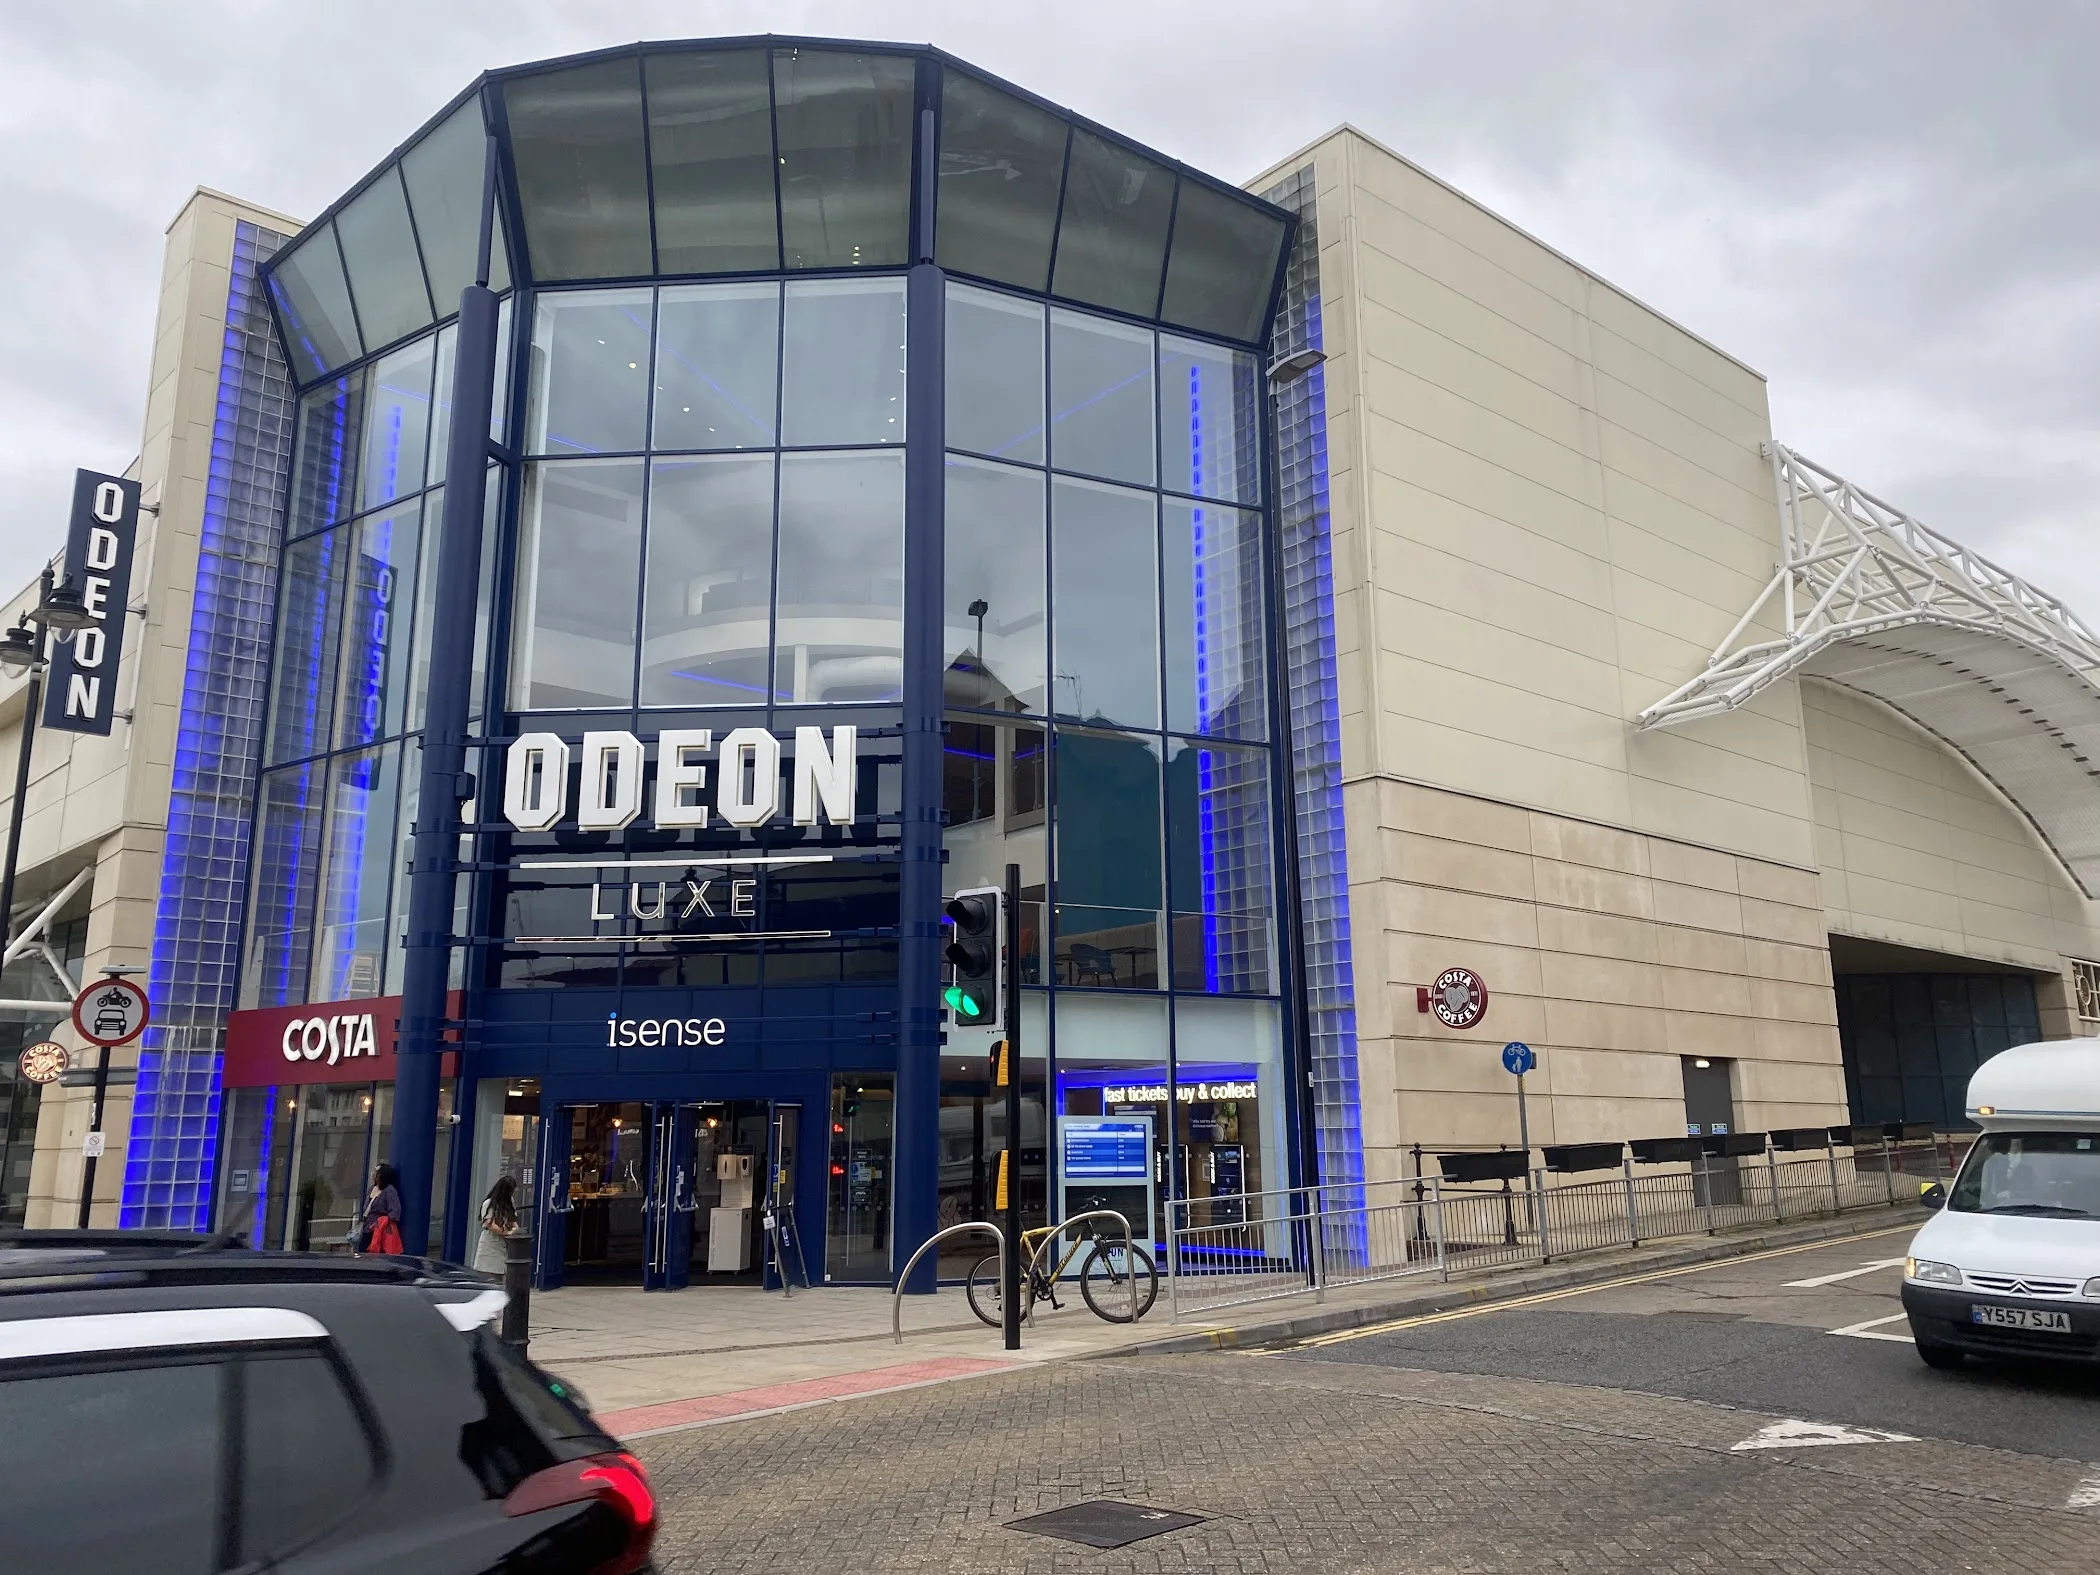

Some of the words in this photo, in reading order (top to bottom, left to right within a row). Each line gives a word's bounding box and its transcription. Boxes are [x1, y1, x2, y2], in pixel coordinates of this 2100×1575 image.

[65, 481, 124, 721] ODEON
[504, 725, 857, 832] ODEON
[590, 879, 757, 920] LUXE
[1438, 971, 1472, 990] COSTA
[1437, 1002, 1478, 1023] COFFEE
[282, 1013, 379, 1066] COSTA
[607, 1011, 727, 1048] isense
[29, 1045, 60, 1057] COSTA
[26, 1065, 63, 1080] COFFEE
[1127, 1085, 1169, 1102] tickets
[1198, 1083, 1208, 1100] &
[1211, 1082, 1257, 1099] collect
[1983, 1306, 2026, 1325] Y557
[2032, 1311, 2066, 1329] SJA
